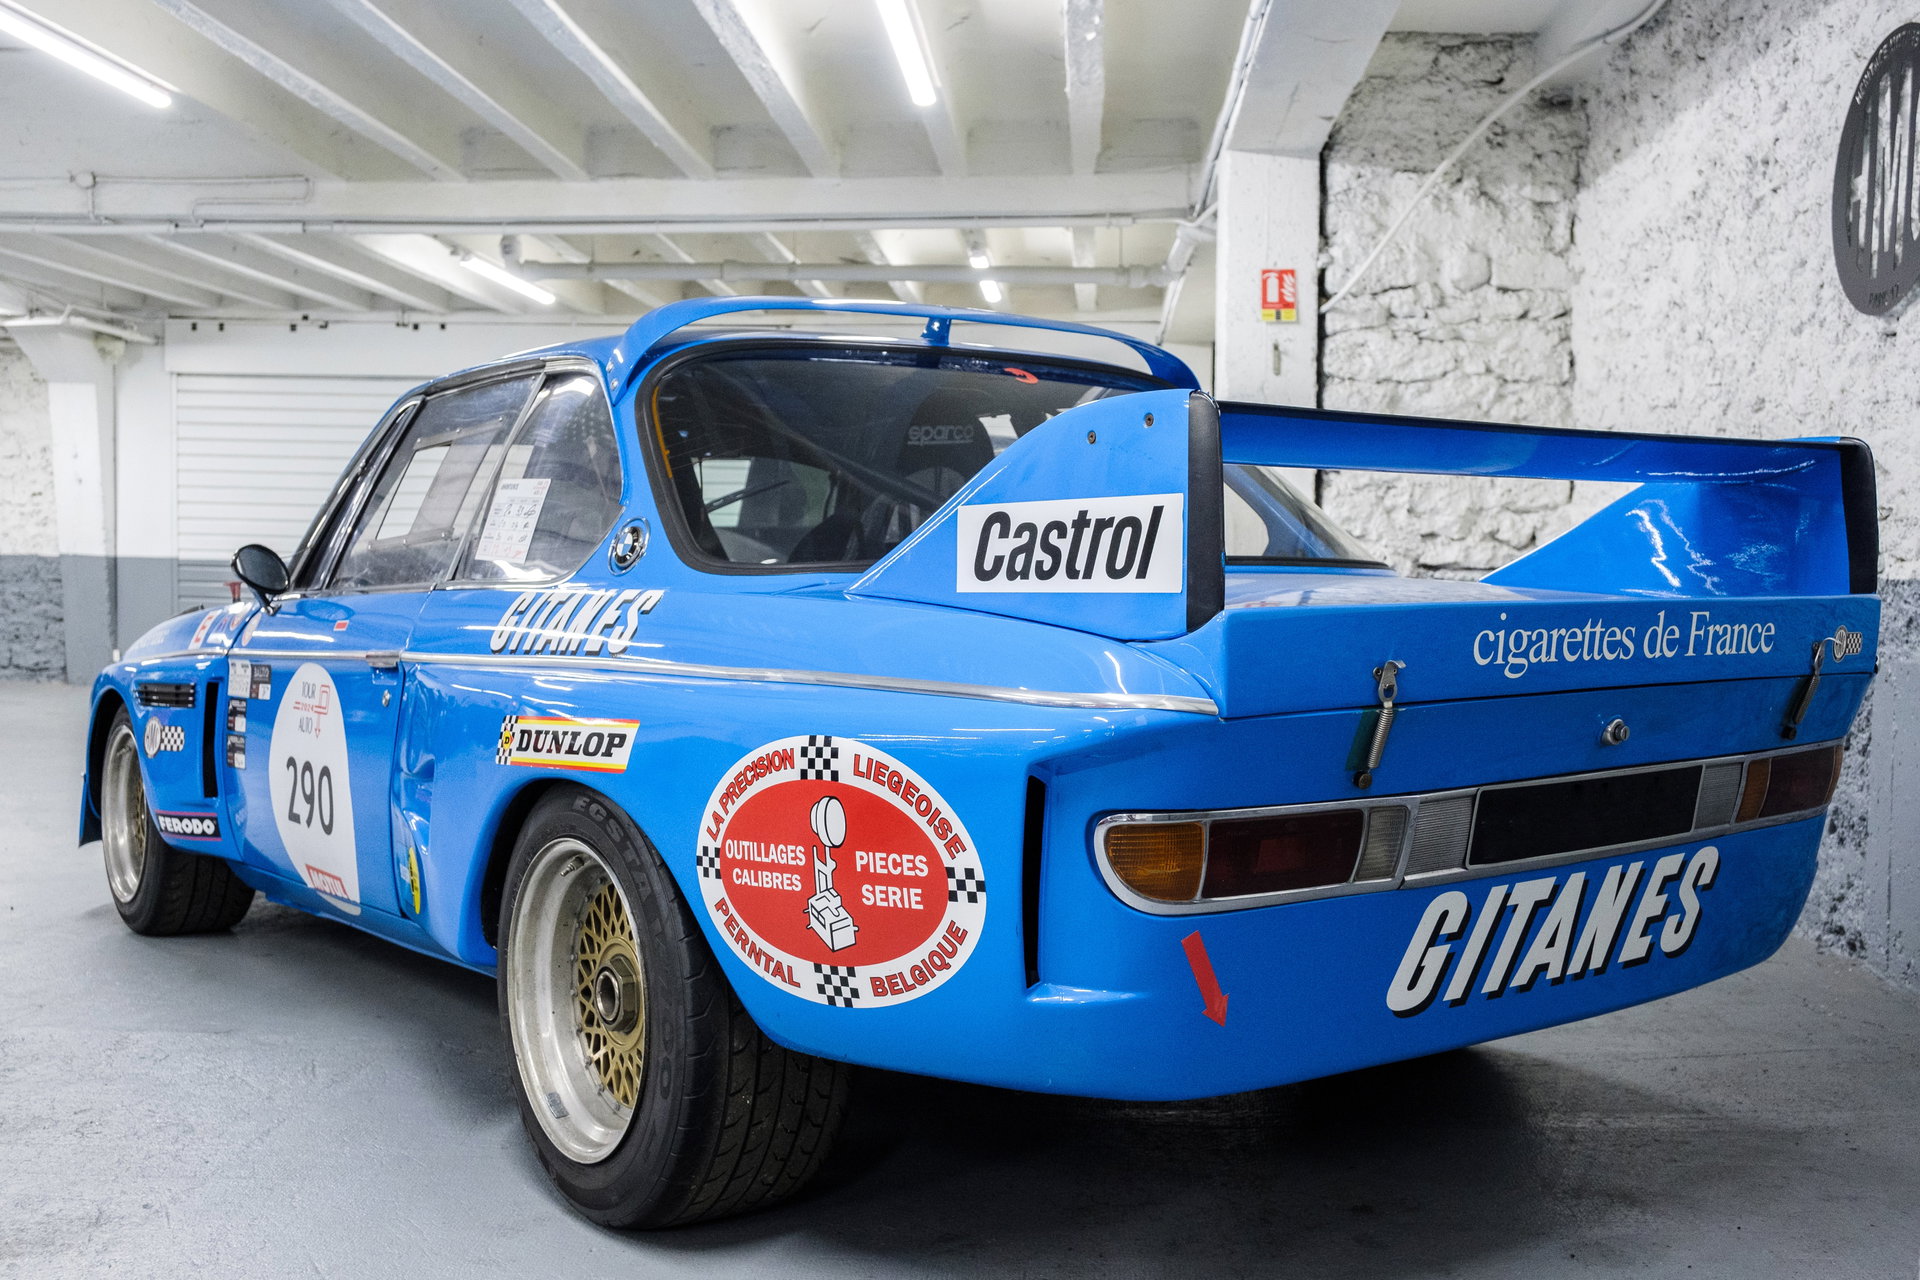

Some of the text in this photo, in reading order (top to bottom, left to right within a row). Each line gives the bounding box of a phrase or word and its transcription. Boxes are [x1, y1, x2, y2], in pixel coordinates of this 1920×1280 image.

[973, 505, 1165, 582] Castrol
[490, 589, 664, 656] GITANES
[1473, 610, 1775, 679] cigarettes de France
[516, 729, 627, 758] DUNLOP
[158, 815, 215, 835] FERODO
[286, 756, 334, 836] 290
[706, 748, 967, 859] LA PRECISION LIEGEOISE
[725, 839, 806, 867] OUTILLAGES
[732, 867, 802, 892] CALIBRES
[855, 850, 929, 877] PIECES
[861, 884, 924, 910] SERIE
[714, 897, 968, 997] PERNTAL BELGIQUE
[1386, 846, 1720, 1017] GITANES
